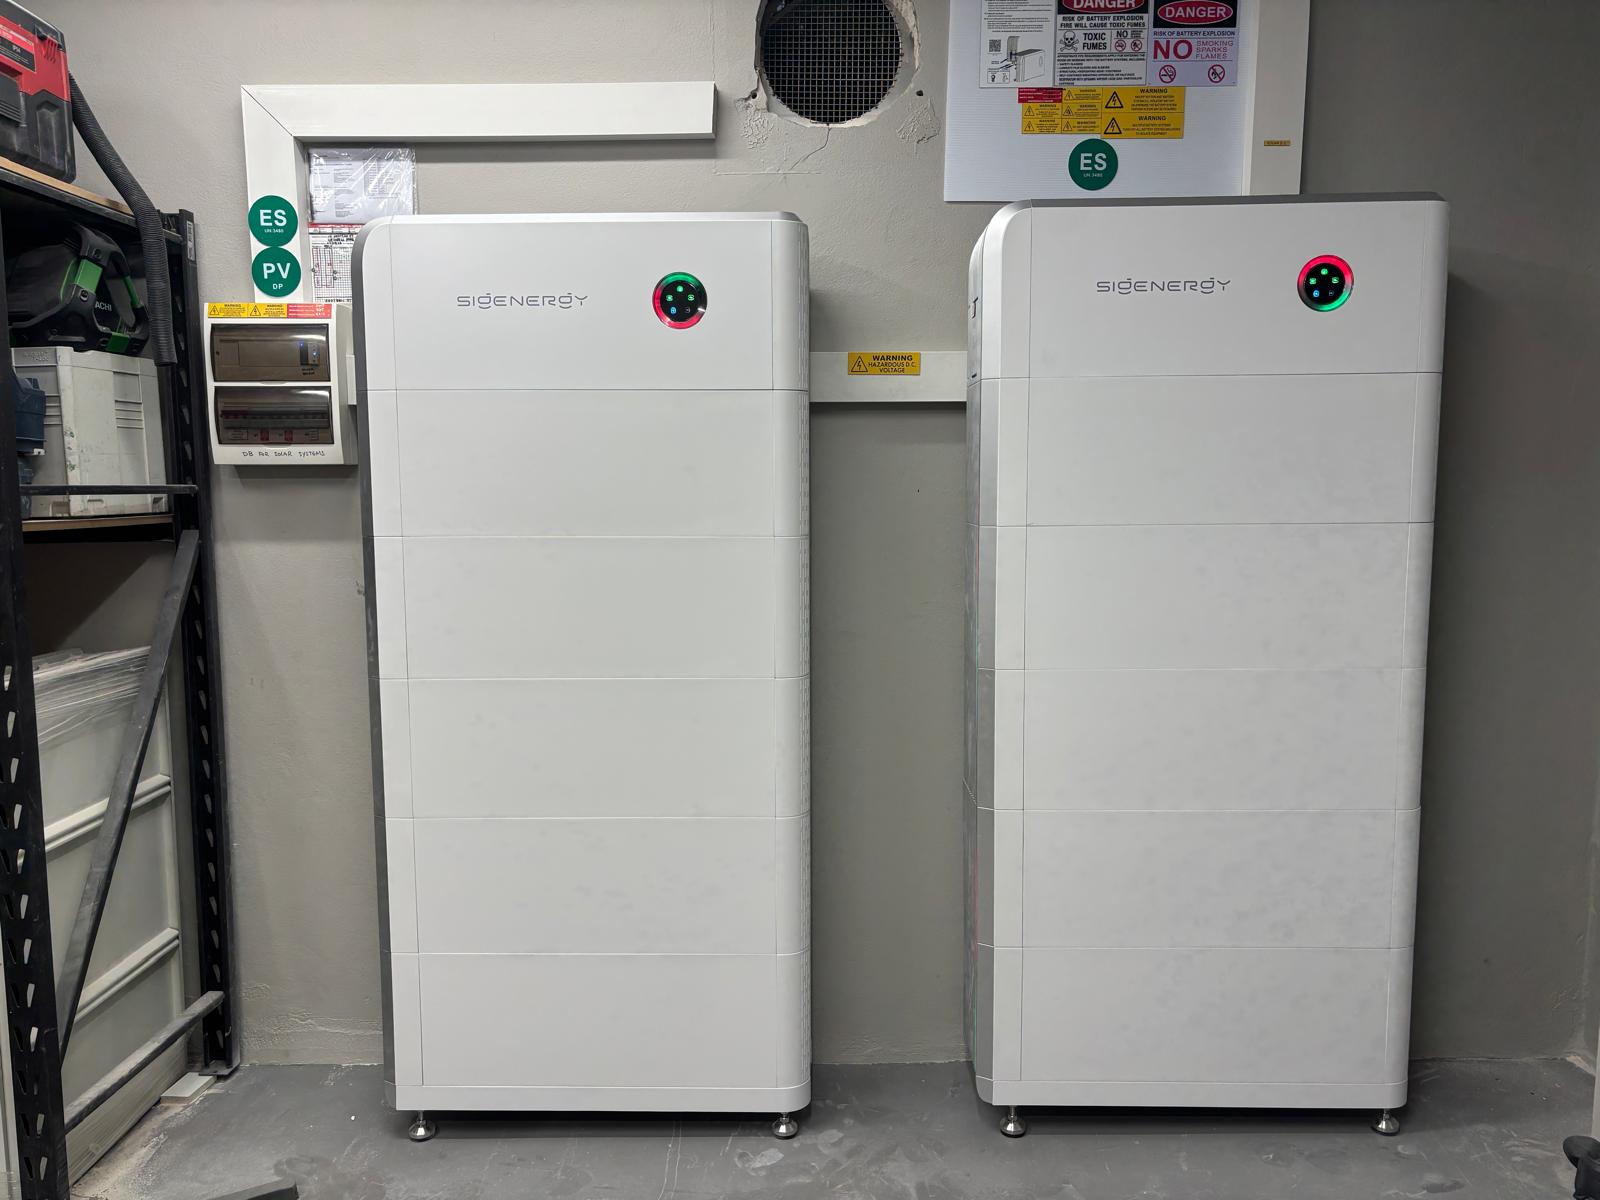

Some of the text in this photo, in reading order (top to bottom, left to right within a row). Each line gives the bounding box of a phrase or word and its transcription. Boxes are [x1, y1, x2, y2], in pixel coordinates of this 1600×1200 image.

[1073, 0, 1136, 8] DANGER
[1165, 6, 1226, 18] DANGER
[1083, 32, 1106, 40] TOXIC
[1116, 30, 1128, 38] NO
[1082, 42, 1107, 50] FUMES
[1153, 39, 1193, 60] NO
[1079, 152, 1107, 171] ES
[259, 209, 287, 227] ES
[262, 262, 291, 279] PV
[1096, 277, 1231, 295] SIGENERGY
[456, 292, 588, 310] SIGENERGY
